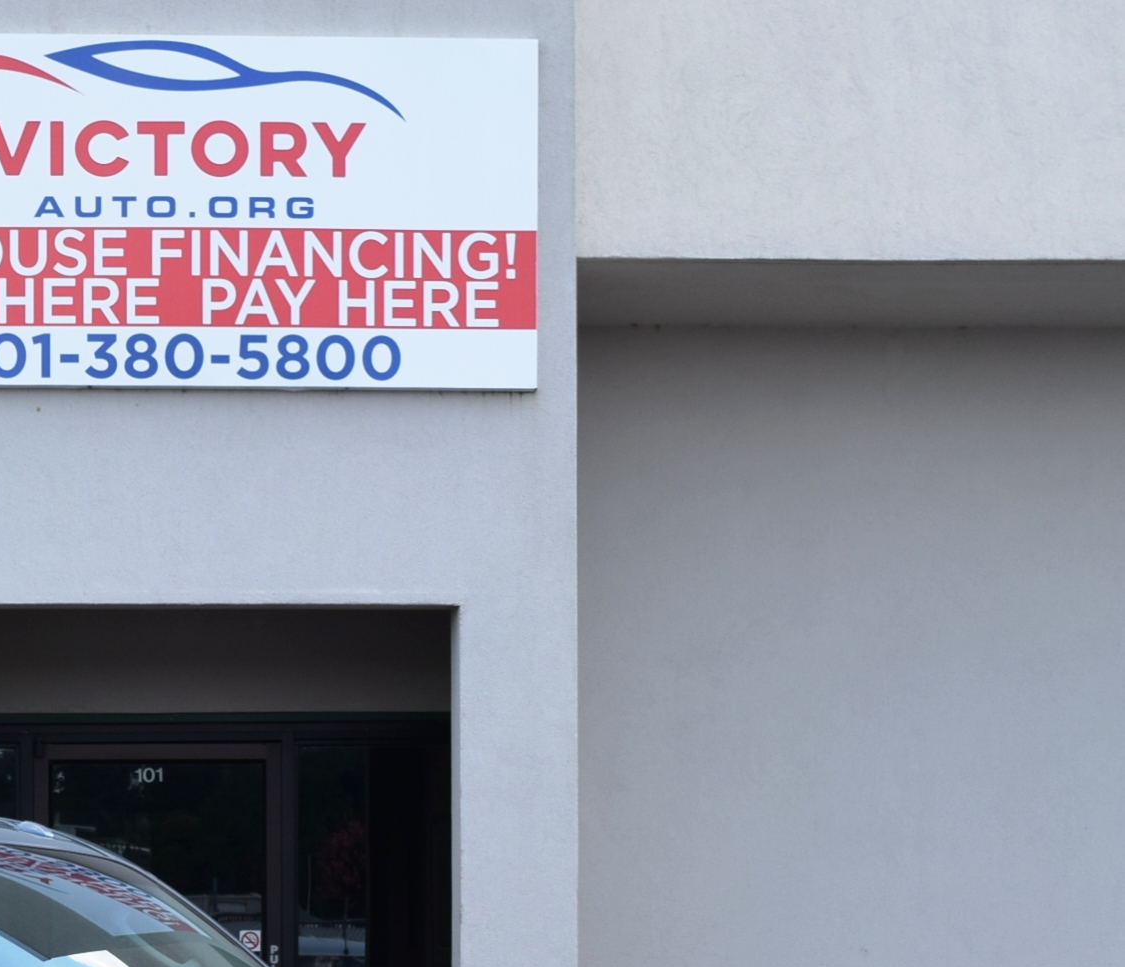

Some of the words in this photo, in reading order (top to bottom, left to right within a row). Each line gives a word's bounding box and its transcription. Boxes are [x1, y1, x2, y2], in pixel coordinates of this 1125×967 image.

[34, 195, 316, 219] AUTO.ORG
[151, 230, 517, 280] FINANCING!
[202, 278, 317, 325] PAY
[338, 280, 500, 327] HERE
[134, 767, 163, 783] 101
